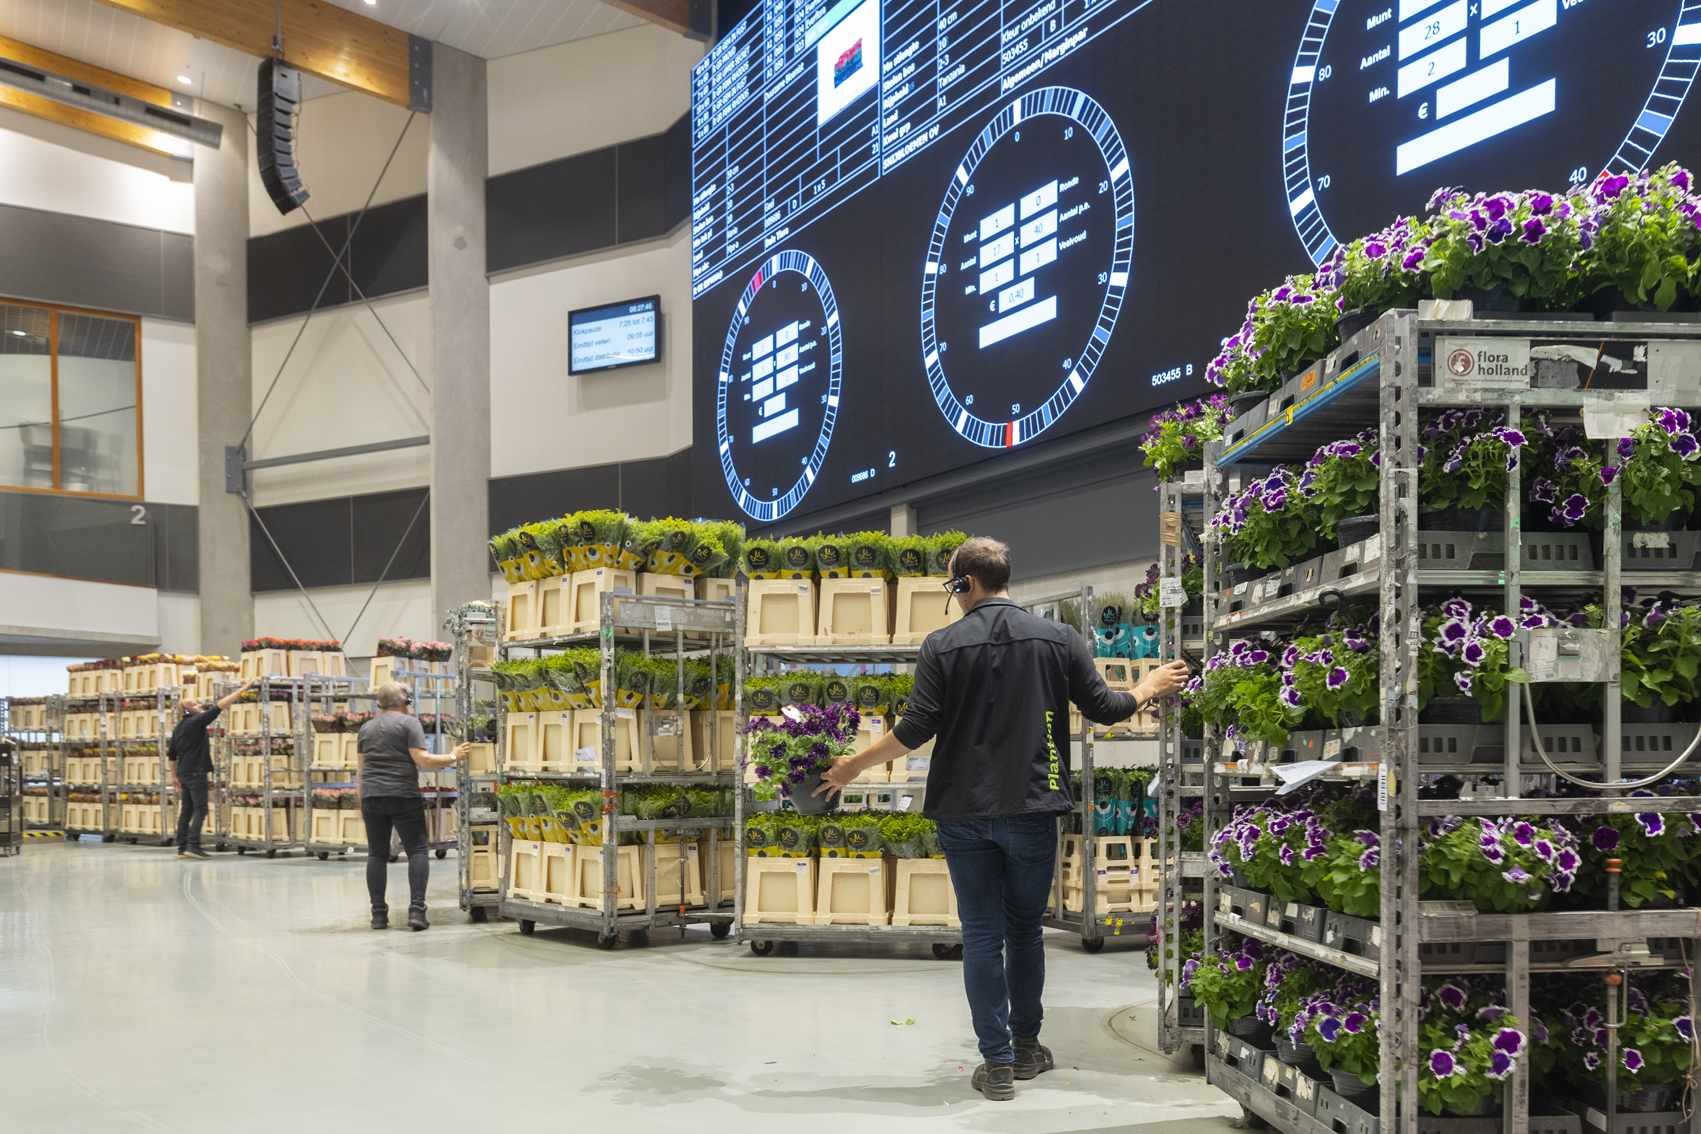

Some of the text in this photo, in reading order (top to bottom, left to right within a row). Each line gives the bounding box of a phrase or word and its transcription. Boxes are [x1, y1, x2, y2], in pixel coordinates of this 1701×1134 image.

[947, 11, 958, 25] cm
[1366, 7, 1392, 31] Munt
[1050, 19, 1057, 33] B
[1424, 20, 1441, 40] 28
[1513, 20, 1521, 36] 1
[1002, 24, 1020, 44] Kleur
[1645, 27, 1667, 49] 30
[1002, 38, 1029, 65] 503455
[1359, 45, 1391, 70] Aantal
[1318, 64, 1332, 82] 80
[1427, 61, 1436, 77] 2
[1369, 85, 1390, 103] Min.
[1417, 102, 1428, 119] €
[1014, 131, 1020, 143] 0
[1063, 125, 1075, 141] 10
[1317, 174, 1331, 191] 70
[1568, 166, 1587, 185] 40
[966, 184, 975, 197] 90
[1059, 176, 1079, 193] Ronde
[1098, 180, 1109, 194] 20
[1035, 195, 1041, 206] 0
[939, 262, 947, 276] 80
[1097, 271, 1108, 285] 30
[619, 319, 631, 328] 7:25
[632, 318, 640, 326] tot
[641, 315, 654, 324] 7:45
[573, 340, 594, 350] Eindtijd
[938, 340, 947, 354] 70
[573, 355, 594, 365] Eindtijd
[1062, 357, 1073, 370] 40
[1477, 351, 1509, 363] flora
[1151, 363, 1193, 387] 503455 B
[1477, 364, 1528, 376] holland
[965, 394, 974, 406] 60
[1011, 403, 1020, 415] 50
[888, 450, 896, 468] 2
[870, 467, 876, 478] D
[130, 505, 147, 526] 2
